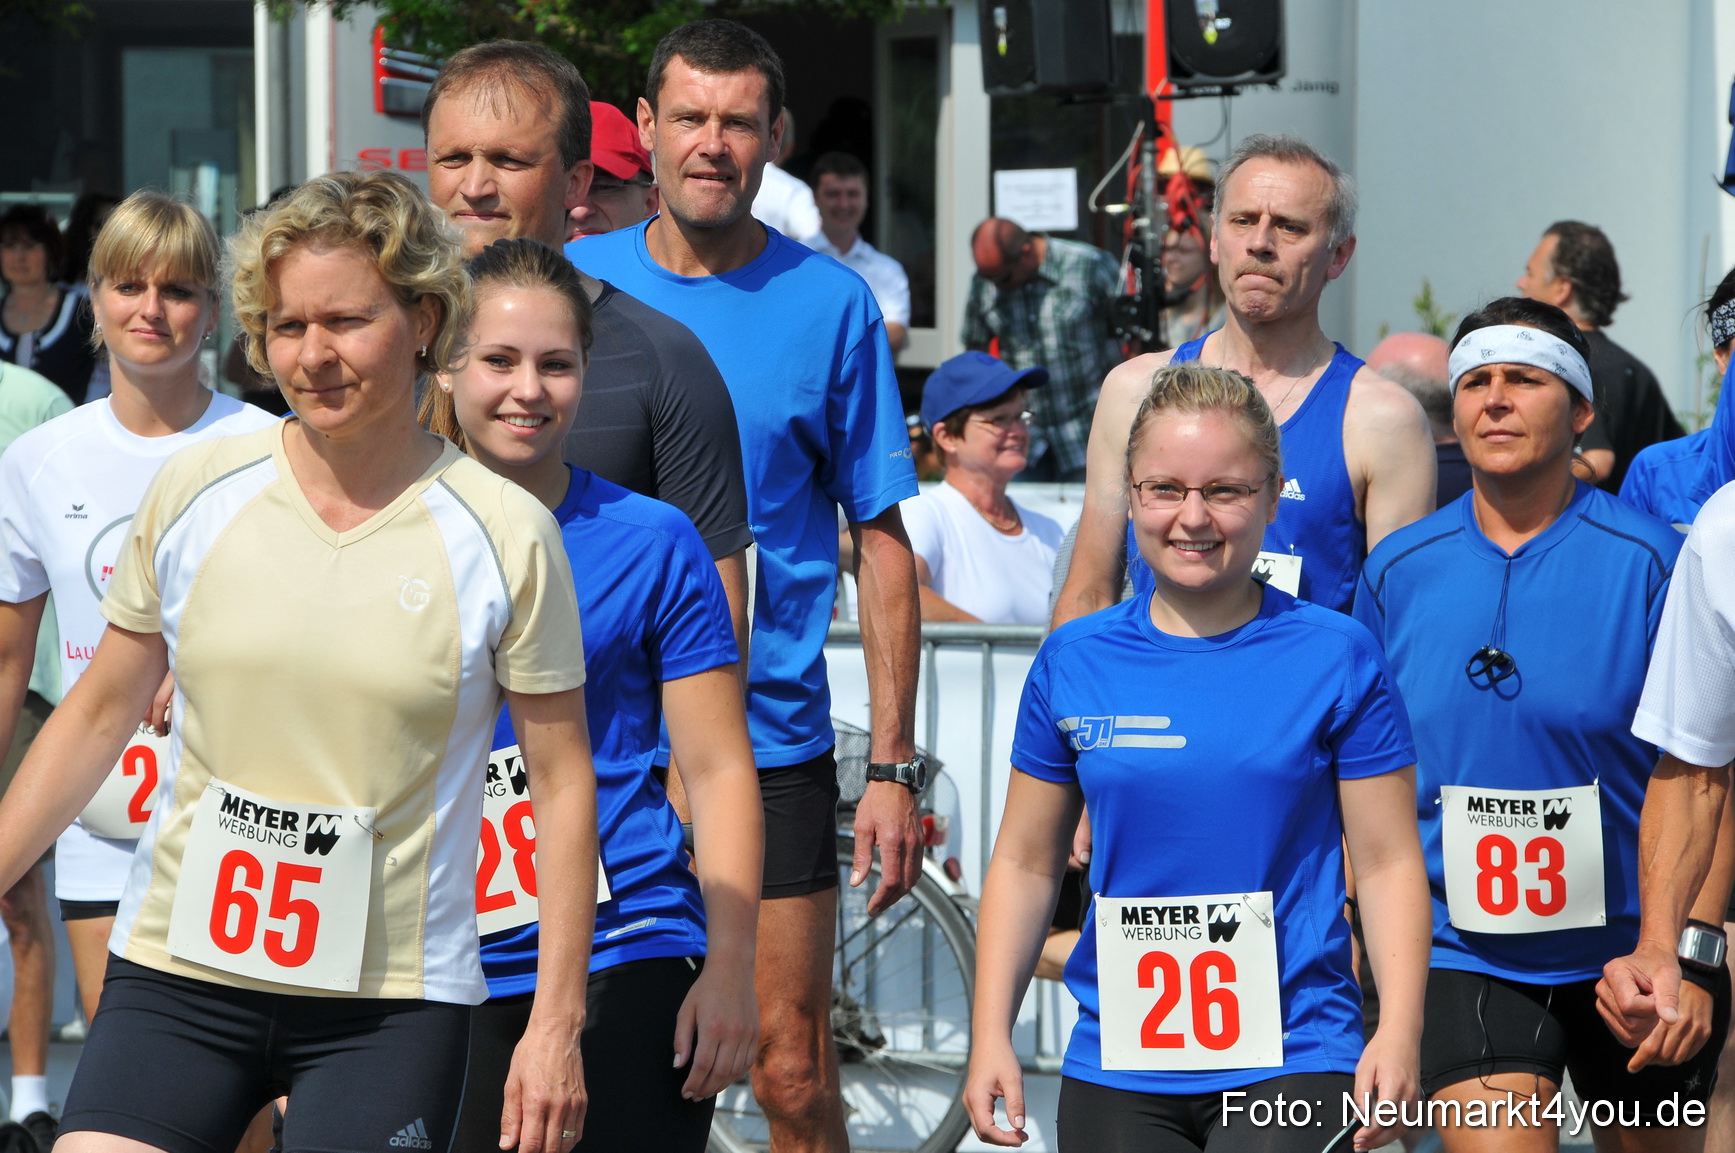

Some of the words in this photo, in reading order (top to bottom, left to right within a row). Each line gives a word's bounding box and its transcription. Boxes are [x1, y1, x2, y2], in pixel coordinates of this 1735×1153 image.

[357, 148, 428, 171] SE
[1280, 489, 1306, 501] didas
[64, 512, 89, 520] erima
[66, 640, 96, 660] LAU
[121, 744, 159, 824] 2
[220, 793, 299, 832] MEYER
[1467, 796, 1537, 815] MEYER
[218, 813, 298, 849] WERBUNG
[1467, 813, 1539, 828] WERBUNG
[475, 800, 538, 914] 28
[1476, 833, 1567, 917] 83
[209, 849, 323, 968] 65
[1121, 905, 1201, 925] MEYER
[1122, 926, 1203, 941] WERBUNG
[1137, 950, 1241, 1051] 26
[389, 1136, 432, 1149] adidas
